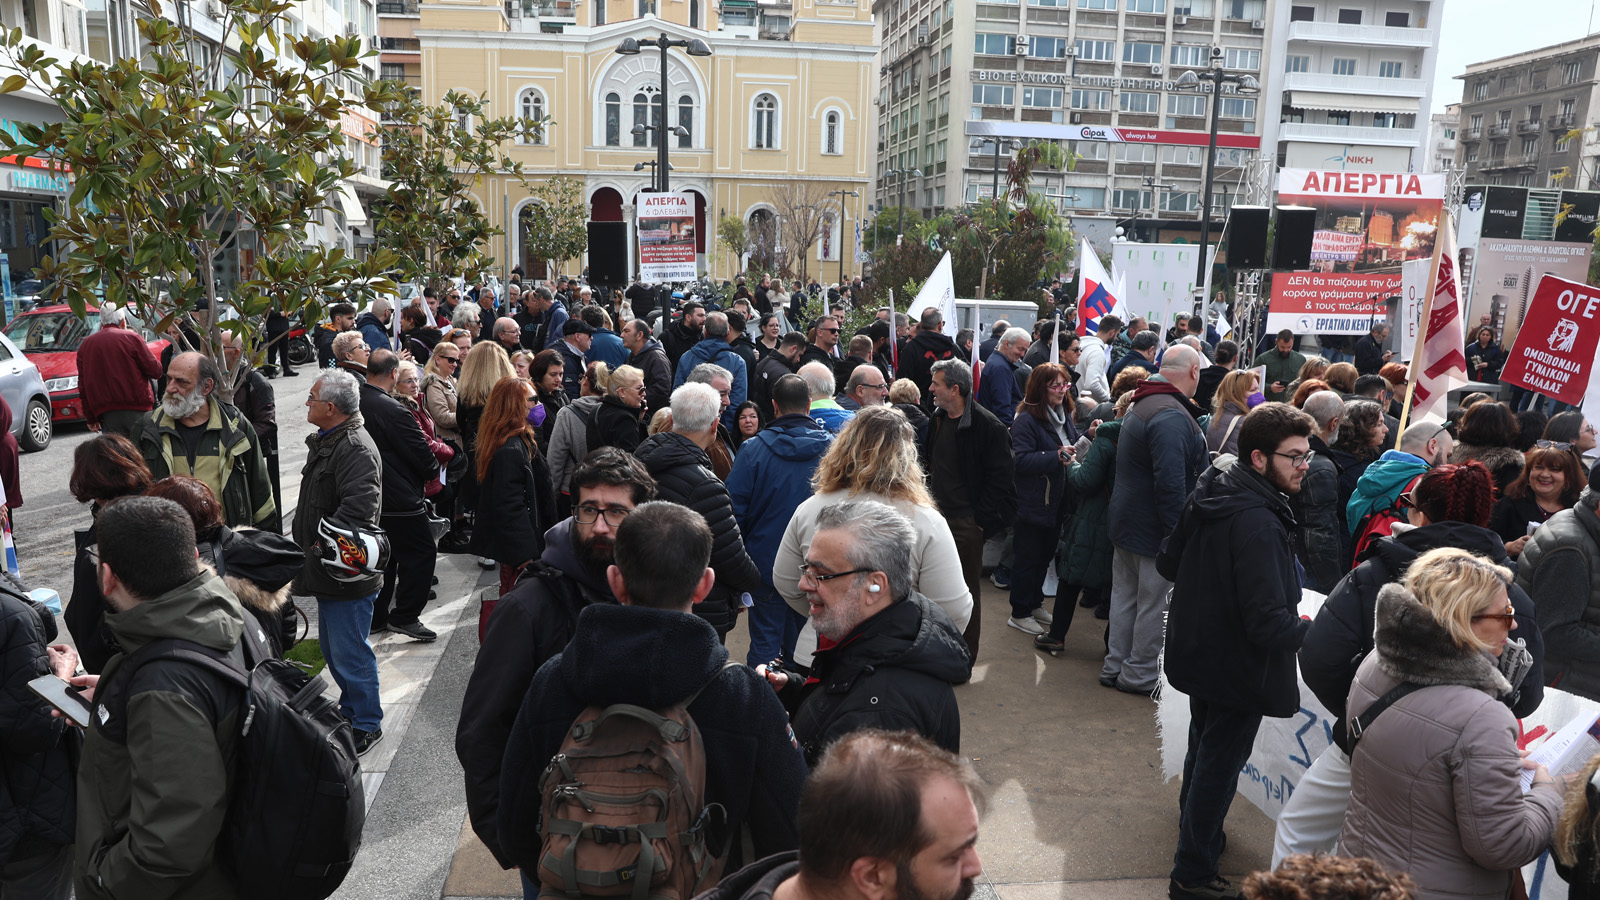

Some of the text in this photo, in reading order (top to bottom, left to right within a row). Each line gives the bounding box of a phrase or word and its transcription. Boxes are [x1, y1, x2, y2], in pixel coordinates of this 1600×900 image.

[979, 70, 1066, 84] ΒΙΟΤΕΧΝΙΚΟΝ
[1080, 76, 1181, 91] ΕΠΙΜΕΛΗΤΗΡΙΟ
[1081, 127, 1106, 139] Calpak
[1125, 132, 1157, 140] always hot
[1346, 155, 1374, 165] ΝΙΚΗ
[14, 171, 69, 192] PHARMACY
[1302, 171, 1422, 195] ΑΠΕΡΓΙΑ
[645, 197, 687, 206] ΑΠΕΡΓΙΑ
[1288, 276, 1310, 286] ΔΕΝ
[1313, 276, 1325, 286] θα
[1327, 277, 1367, 289] παίζουμε
[1370, 279, 1384, 289] την
[1283, 289, 1317, 299] κορόνα
[1320, 289, 1363, 300] γράμματα
[1366, 291, 1379, 299] για
[1305, 301, 1312, 310] &
[1315, 302, 1336, 311] τους
[1339, 302, 1381, 312] πολέμους
[1557, 290, 1600, 319] ΟΓΕ
[1316, 318, 1351, 331] ΕΡΓΑΤΙΚΟ
[1352, 318, 1378, 331] ΚΕΝΤ
[1523, 346, 1581, 374] ΟΜΟΣΠΟΝΔΙΑ
[1525, 360, 1571, 383] ΓΥΝΑΙΚΩΝ
[1522, 372, 1563, 394] ΕΛΛΑΔΑΣ
